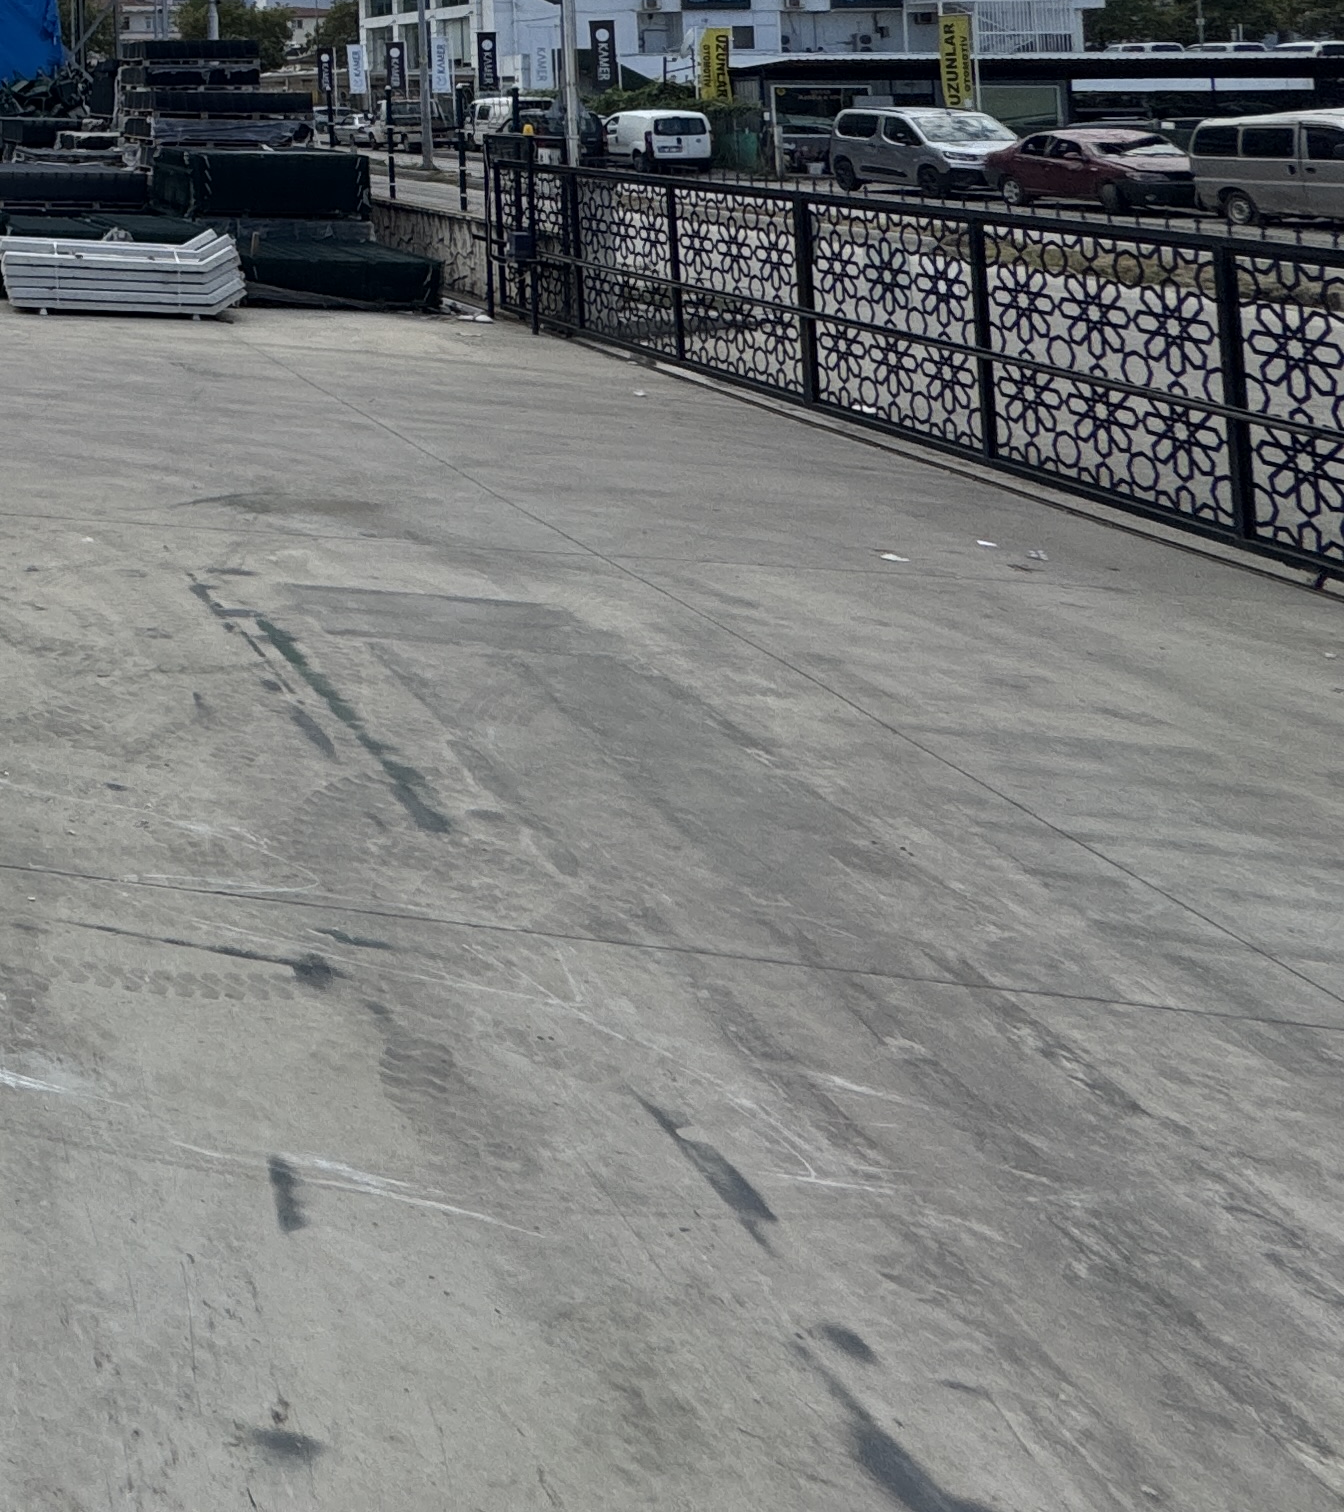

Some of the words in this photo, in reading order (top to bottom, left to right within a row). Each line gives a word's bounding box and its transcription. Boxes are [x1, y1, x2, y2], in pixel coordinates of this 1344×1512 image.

[391, 58, 401, 87] KAMER
[437, 44, 446, 75] KAMER
[483, 51, 493, 85] KAMER
[537, 47, 548, 82] KAMER
[598, 42, 610, 81] KAMER
[715, 34, 729, 98] UZUNLAR
[943, 22, 961, 106] UZUNLAR
